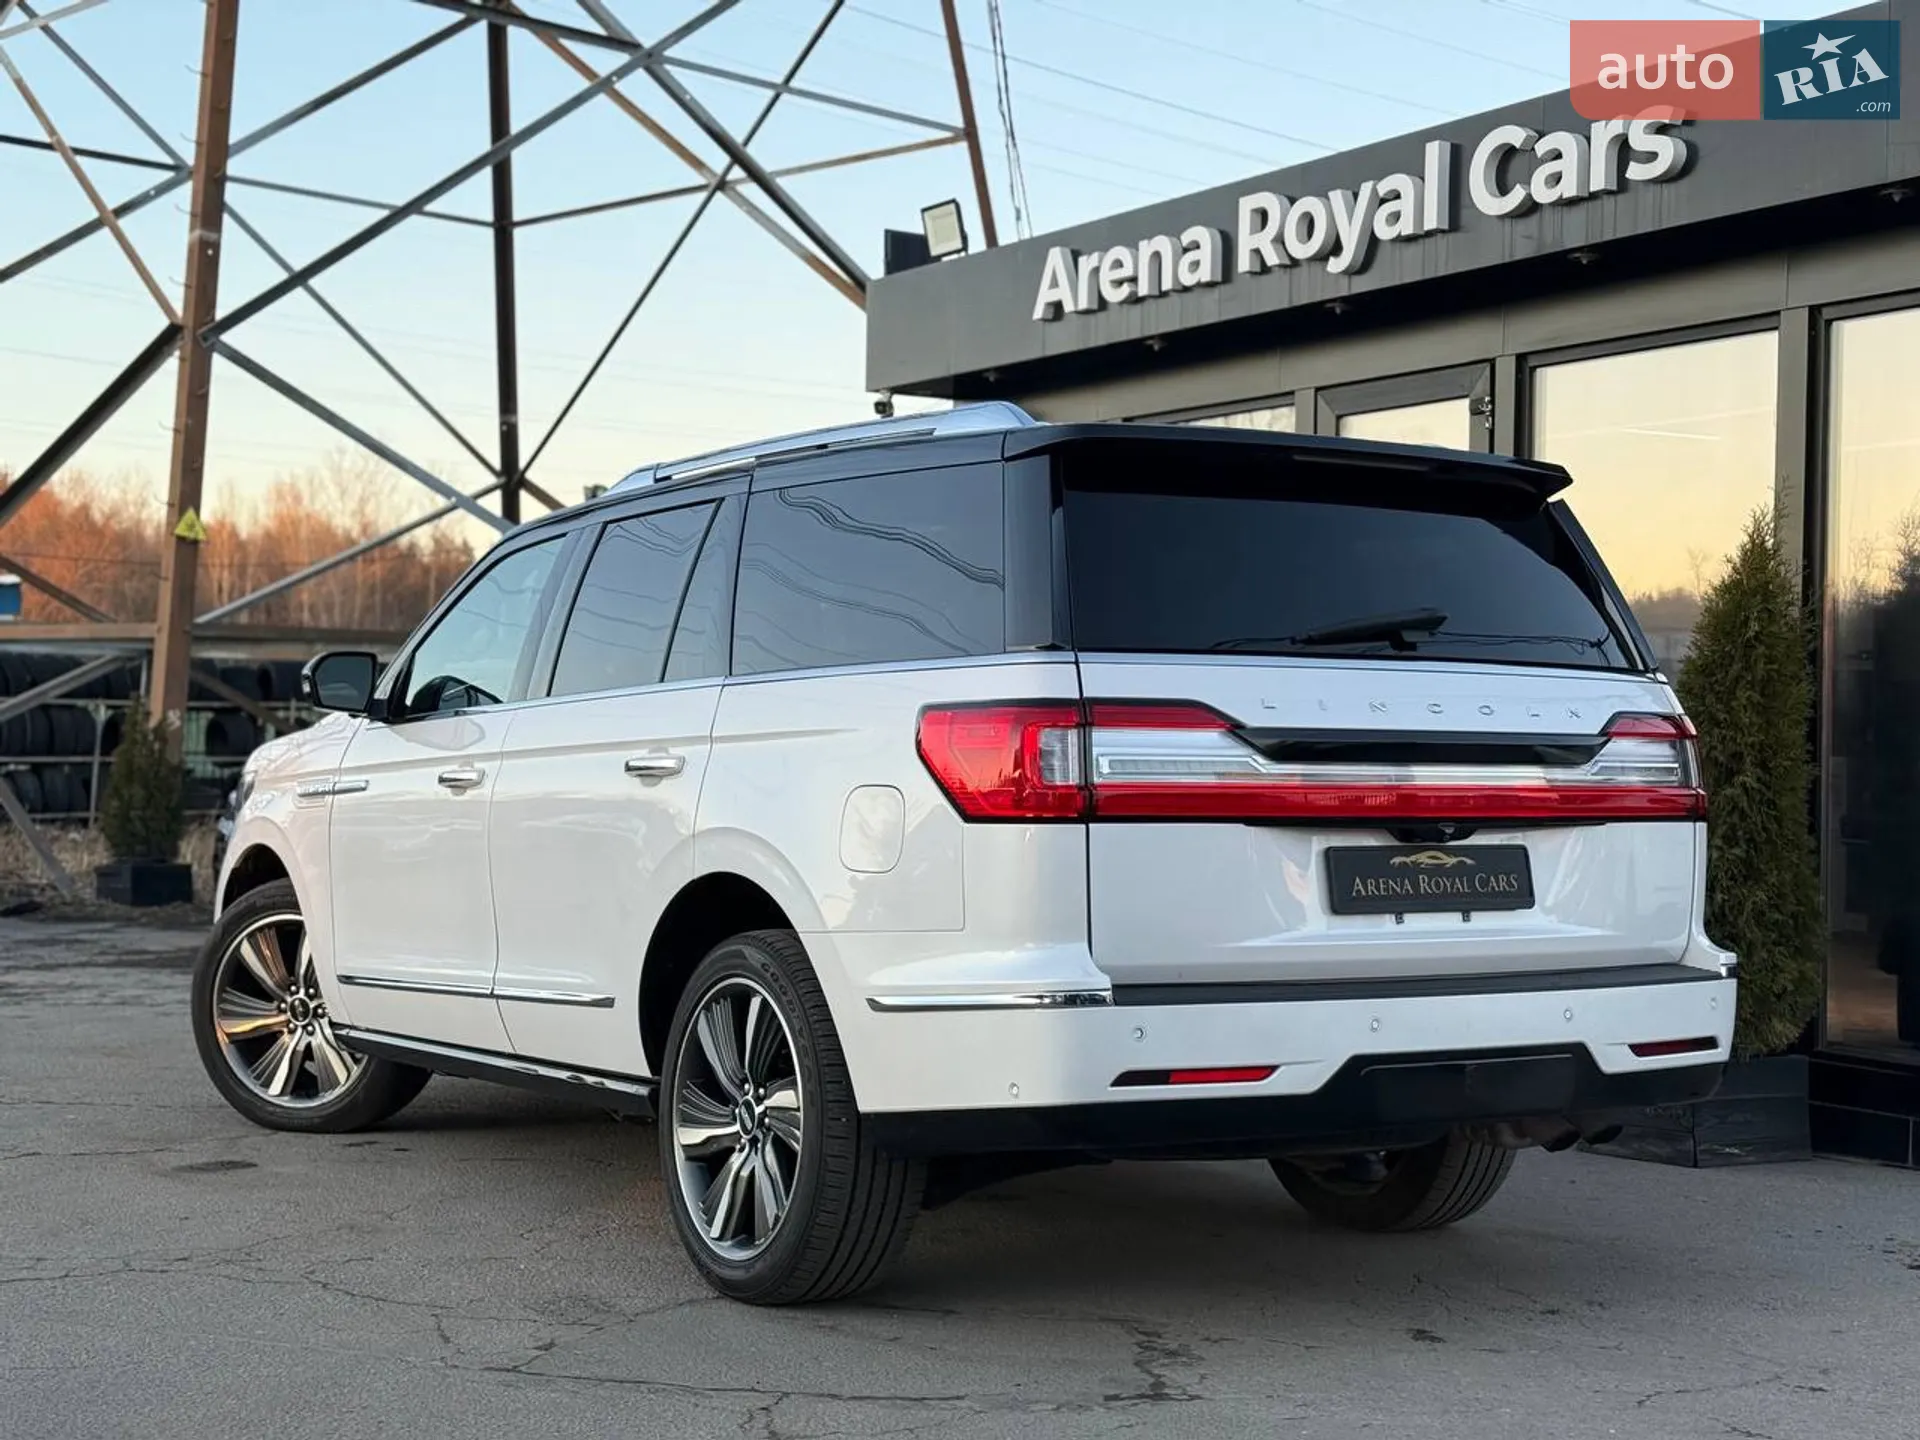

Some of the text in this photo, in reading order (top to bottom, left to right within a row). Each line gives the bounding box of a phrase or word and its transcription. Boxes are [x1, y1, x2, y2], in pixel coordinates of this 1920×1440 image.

[1032, 104, 1689, 322] Arena Royal Cars
[1352, 872, 1518, 897] ARENA ROYAL CARS
